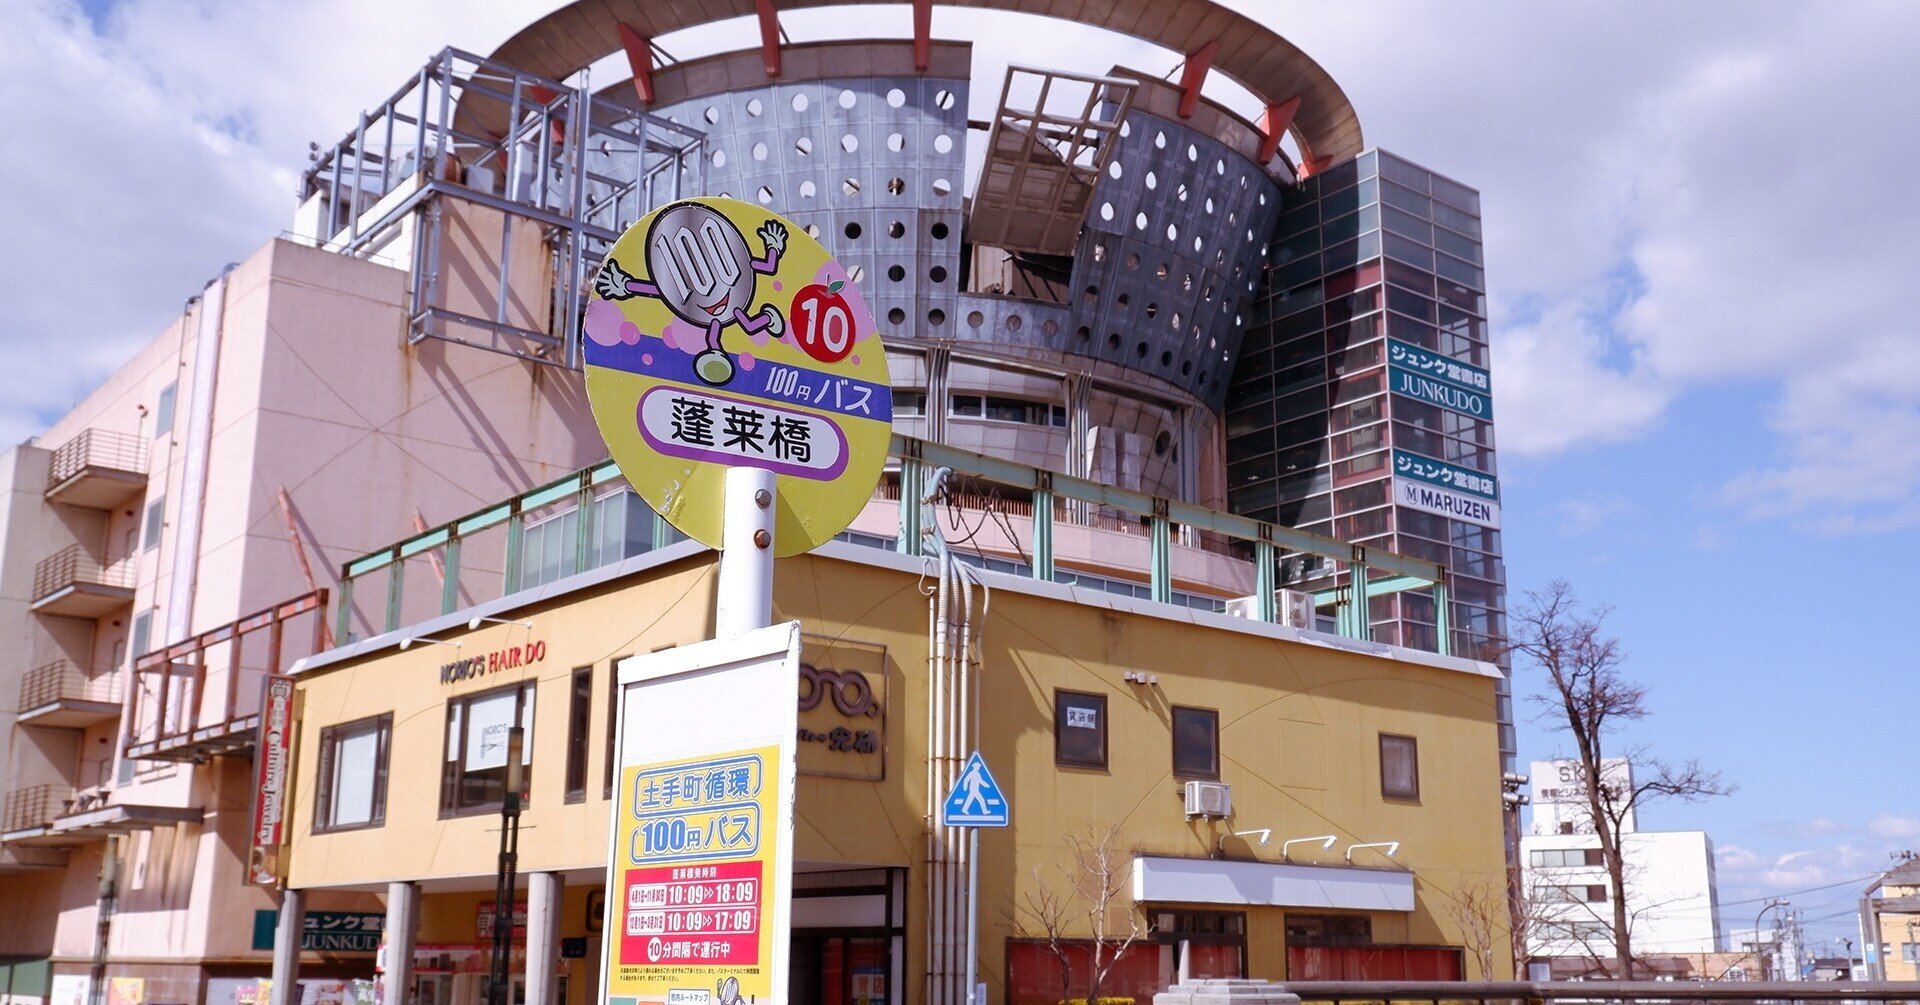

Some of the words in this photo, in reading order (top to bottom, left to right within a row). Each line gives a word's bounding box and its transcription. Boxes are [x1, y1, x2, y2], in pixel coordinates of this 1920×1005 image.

[655, 217, 743, 304] 100
[801, 298, 849, 354] 10
[1391, 344, 1488, 390] ジュンク堂書店
[1400, 374, 1483, 415] JUNKUDO
[671, 396, 812, 465] 蓬莱橋
[1397, 455, 1494, 496] ジュンク堂書店
[1420, 488, 1491, 521] MARUZEN
[440, 655, 485, 686] NORIO'S
[488, 646, 522, 674] HAIR
[525, 639, 546, 665] DO
[266, 730, 281, 785] Culture
[641, 767, 750, 808] 土手町循環
[258, 785, 277, 843] Jewelry
[642, 815, 752, 854] 100円バス
